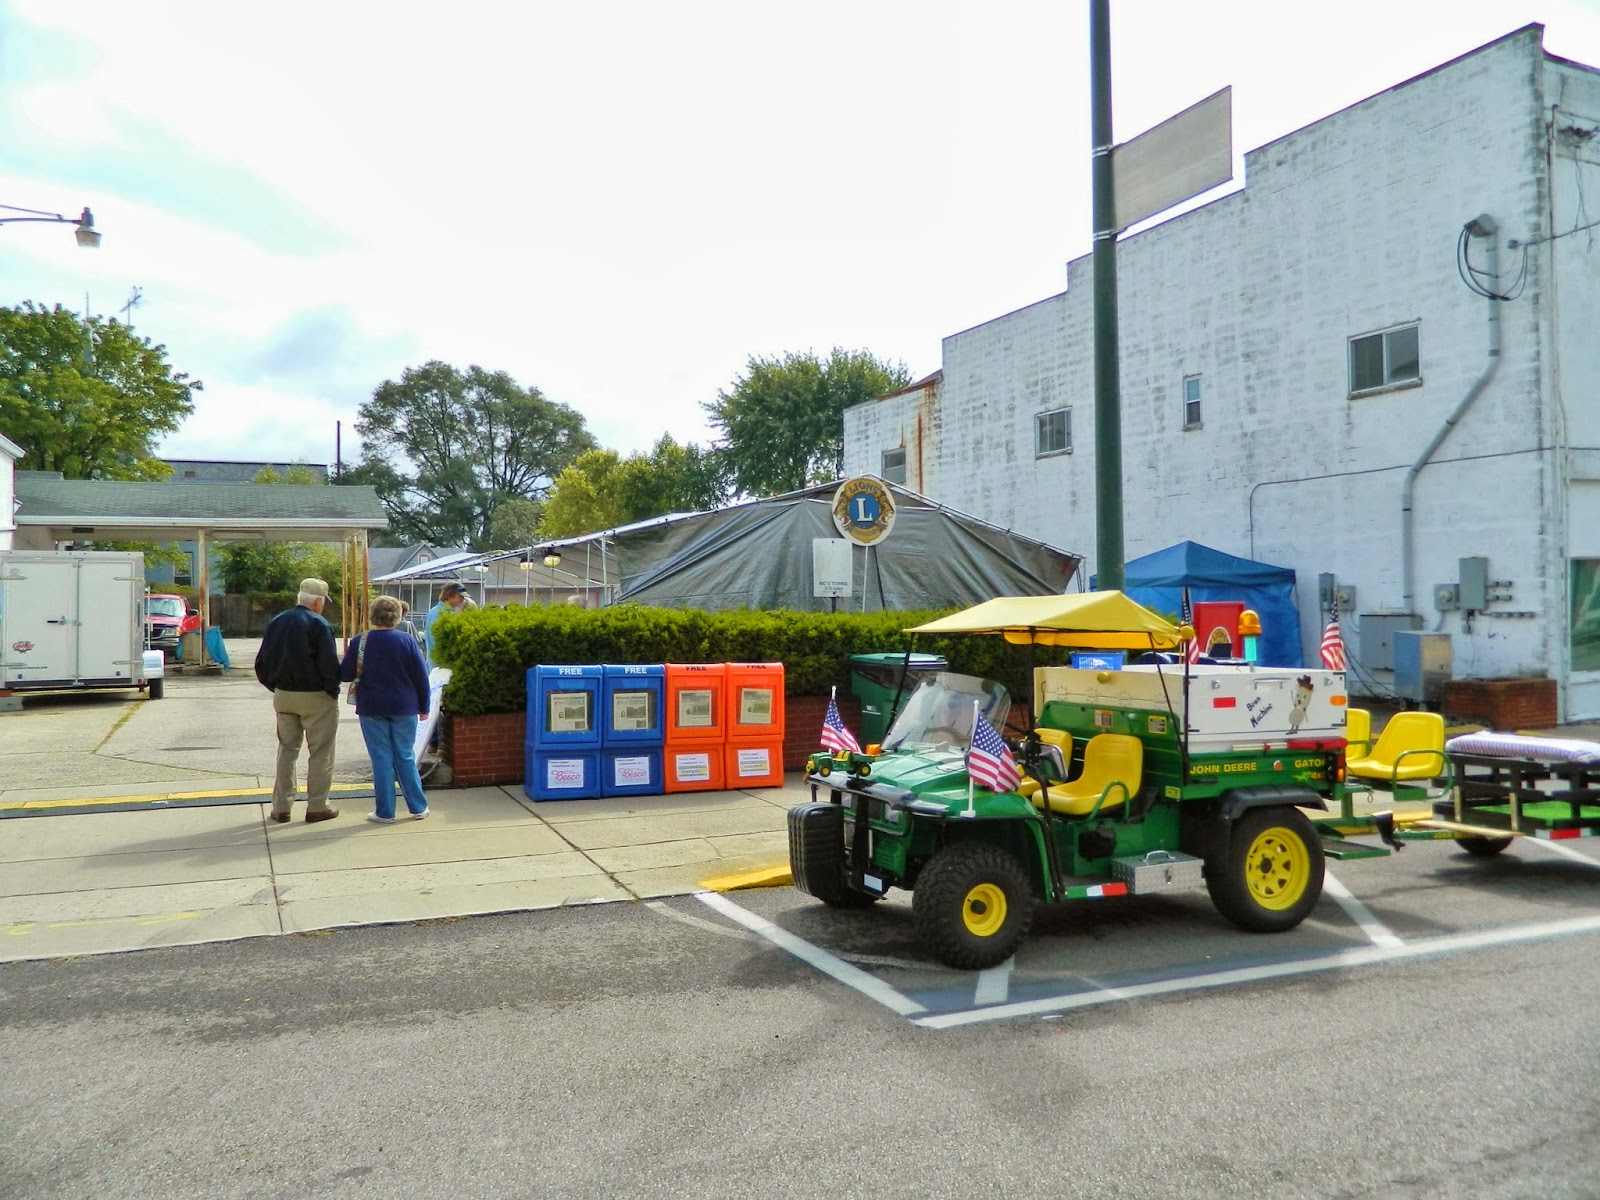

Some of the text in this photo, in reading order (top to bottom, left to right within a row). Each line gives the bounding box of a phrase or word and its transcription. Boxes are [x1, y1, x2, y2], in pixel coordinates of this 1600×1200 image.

[849, 483, 879, 495] LIONS
[856, 498, 873, 521] L
[1250, 703, 1273, 728] Machine
[1190, 762, 1257, 775] JOHN DEERE
